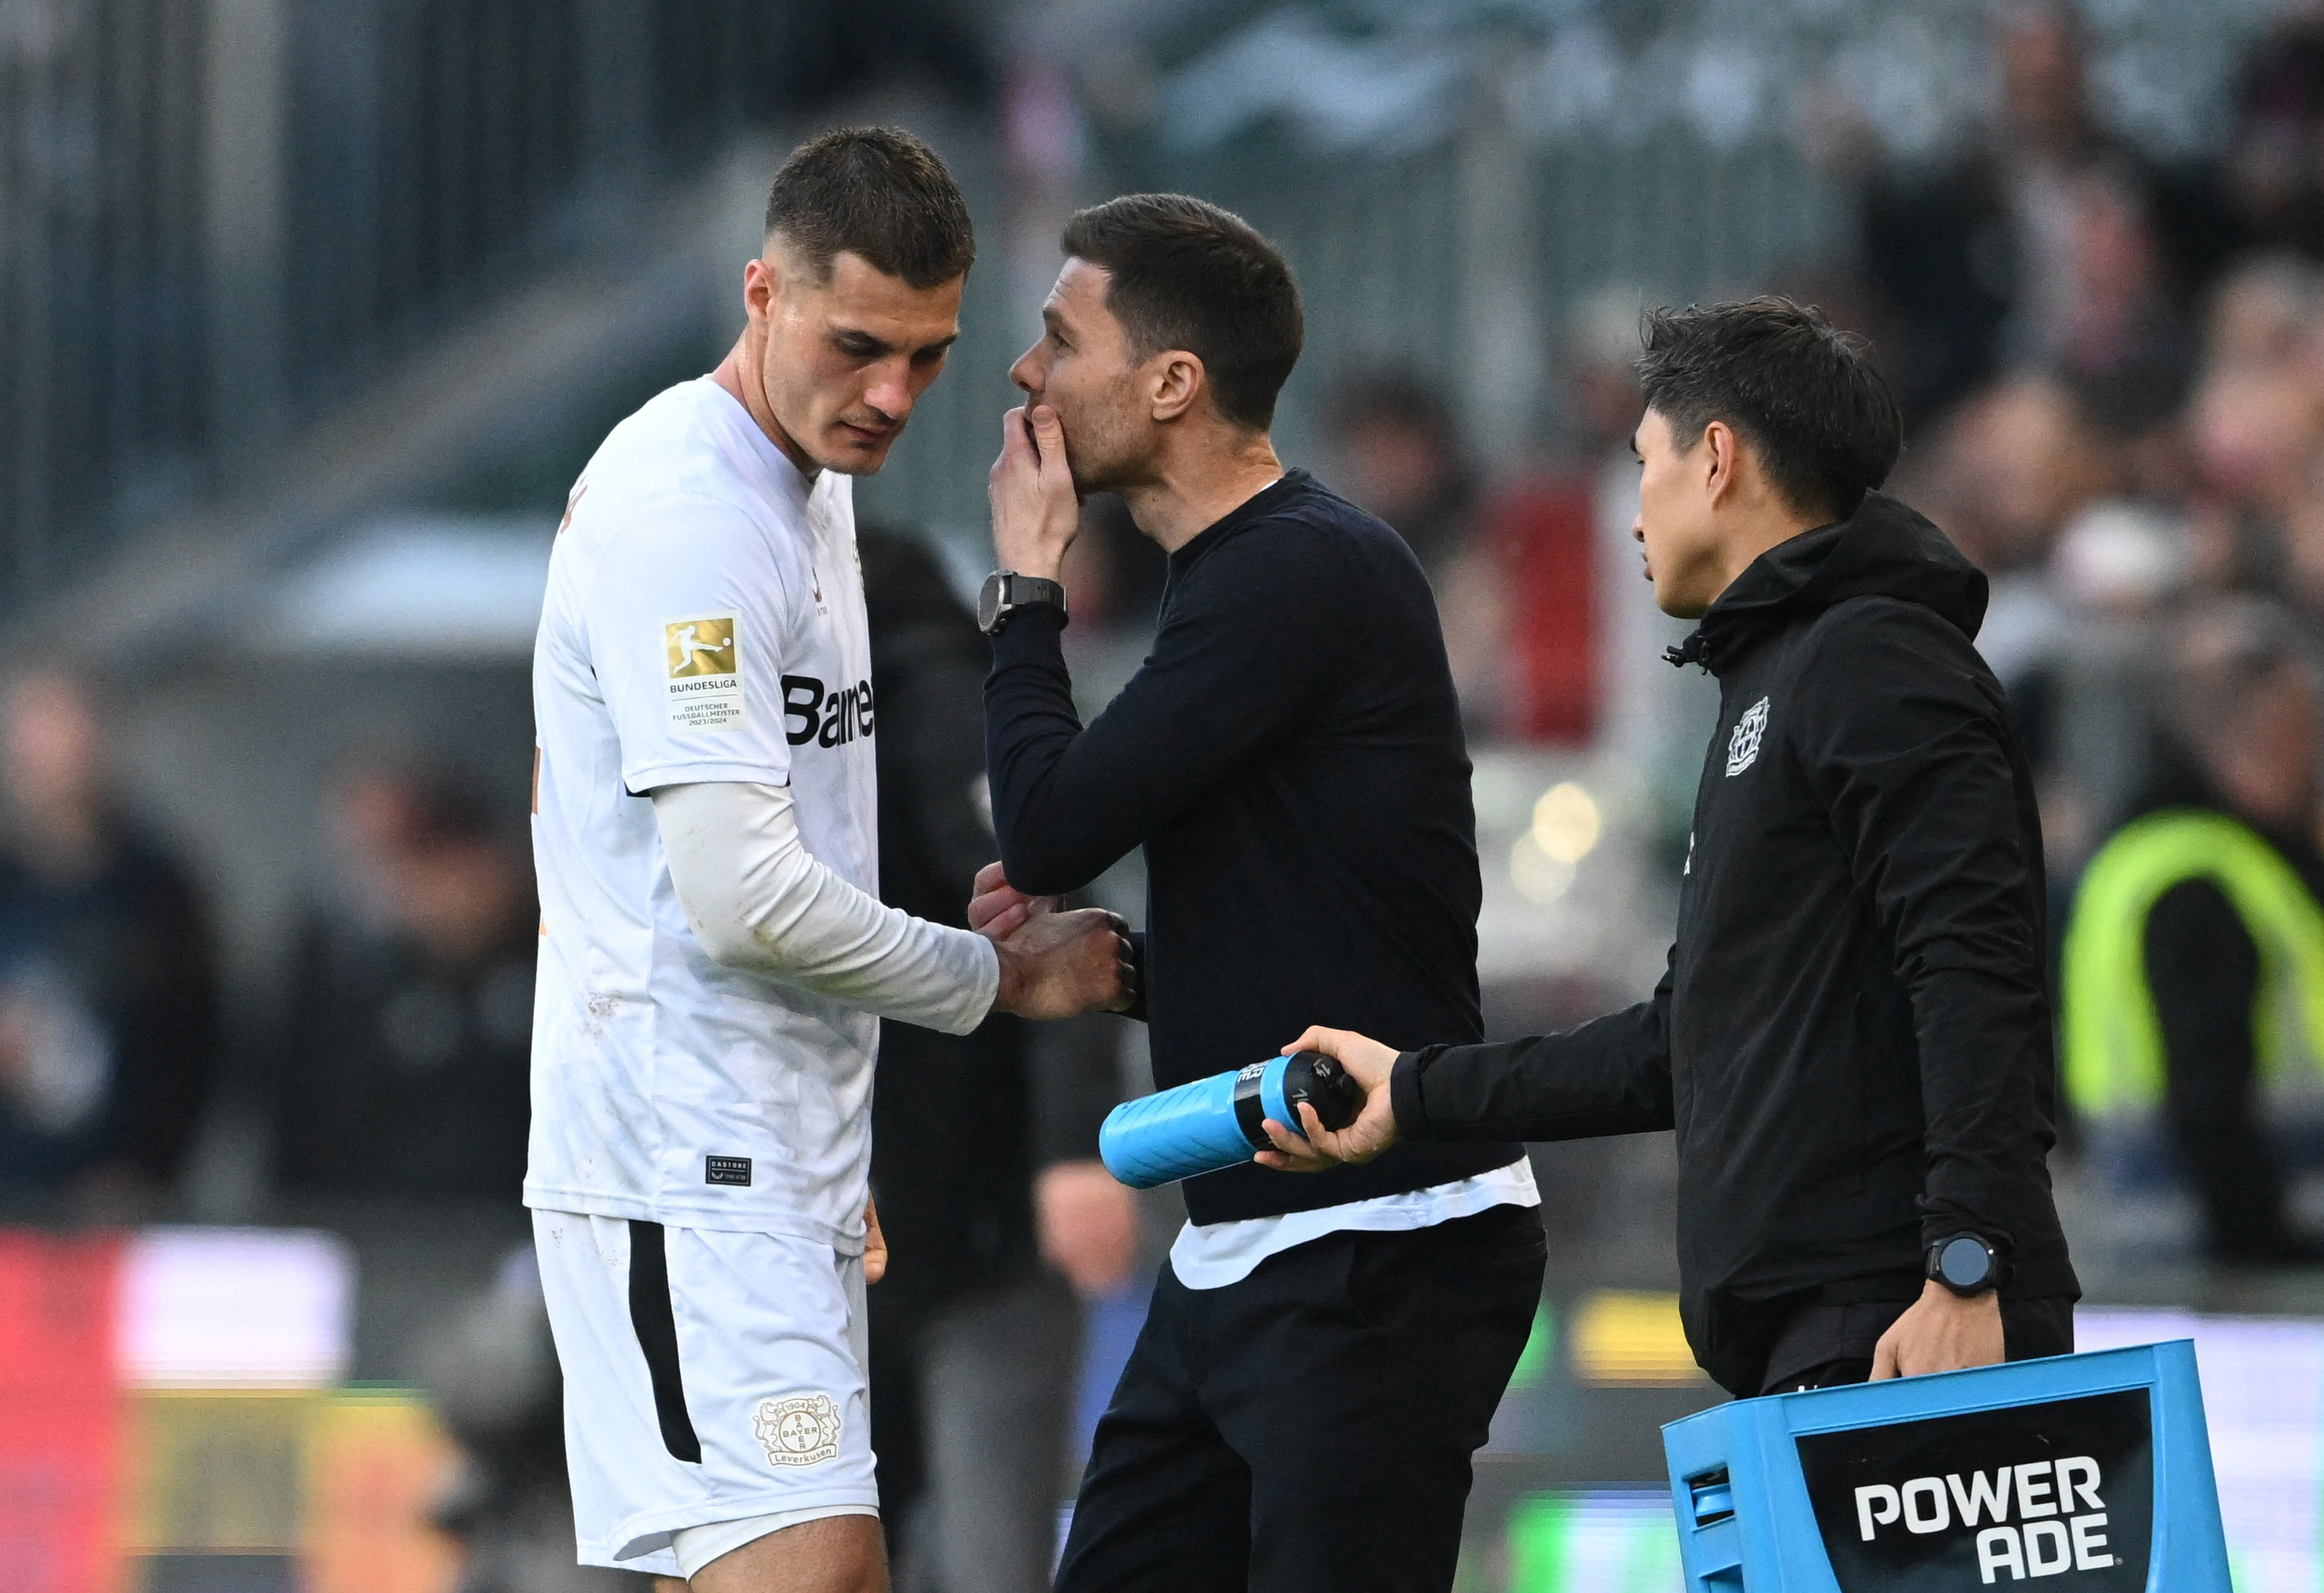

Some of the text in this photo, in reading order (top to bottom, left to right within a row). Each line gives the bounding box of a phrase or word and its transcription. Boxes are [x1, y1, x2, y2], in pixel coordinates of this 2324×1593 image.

[670, 680, 737, 693] BUNDESLIGA
[684, 703, 728, 713] DEUTSCHER
[673, 709, 740, 721] FUSSBALLMEISTER
[689, 717, 727, 727] 2023/2024
[786, 1402, 806, 1411] 1904
[782, 1426, 818, 1438] BAYER
[794, 1414, 806, 1450] BAYER
[775, 1448, 832, 1463] Leverkusen
[1854, 1455, 2106, 1541] POWER
[1976, 1512, 2114, 1585] ADE
